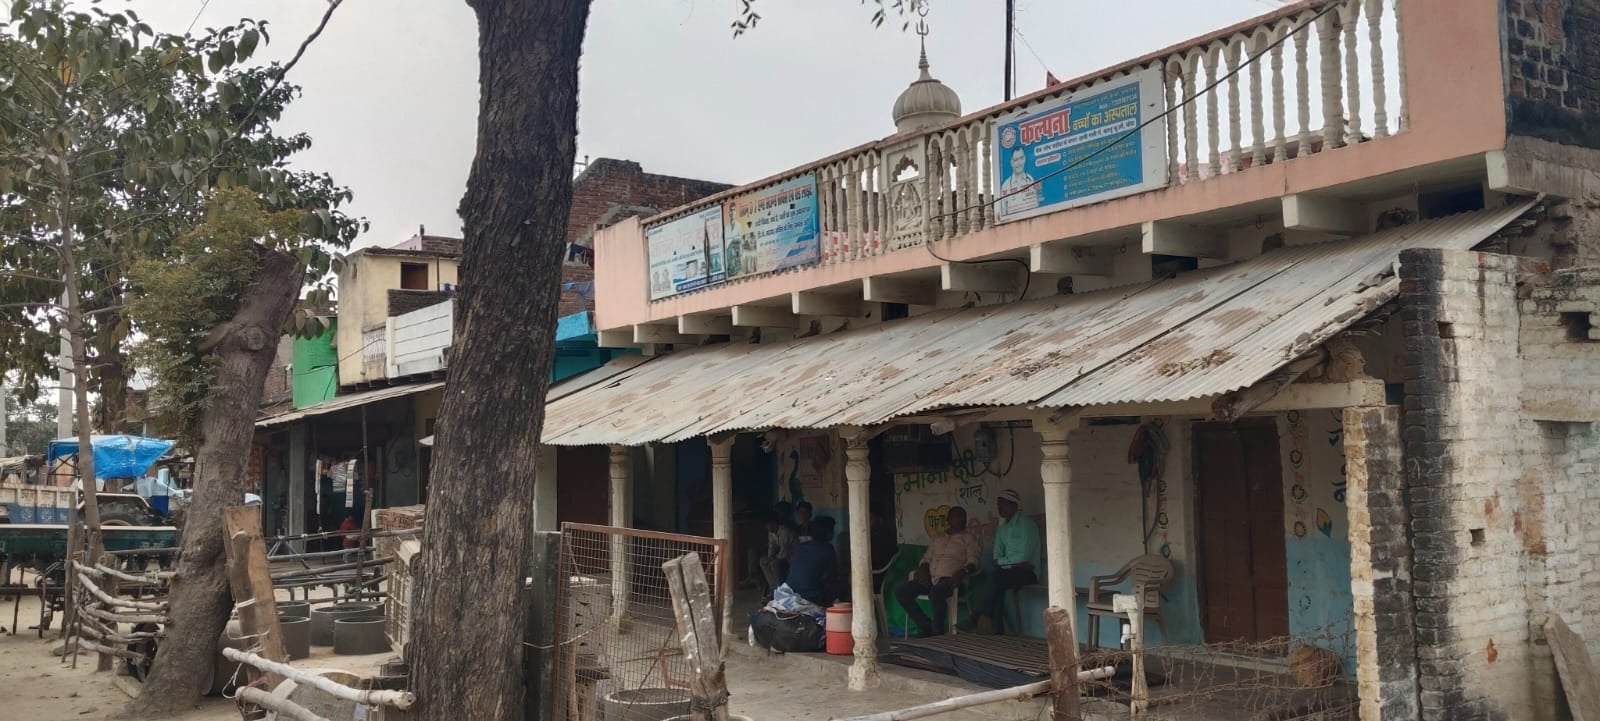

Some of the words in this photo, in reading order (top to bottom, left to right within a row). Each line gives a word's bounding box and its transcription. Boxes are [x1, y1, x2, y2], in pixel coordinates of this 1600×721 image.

[1020, 109, 1070, 144] कल्पना
[1092, 112, 1102, 126] का
[1103, 103, 1137, 122] अस्पताल
